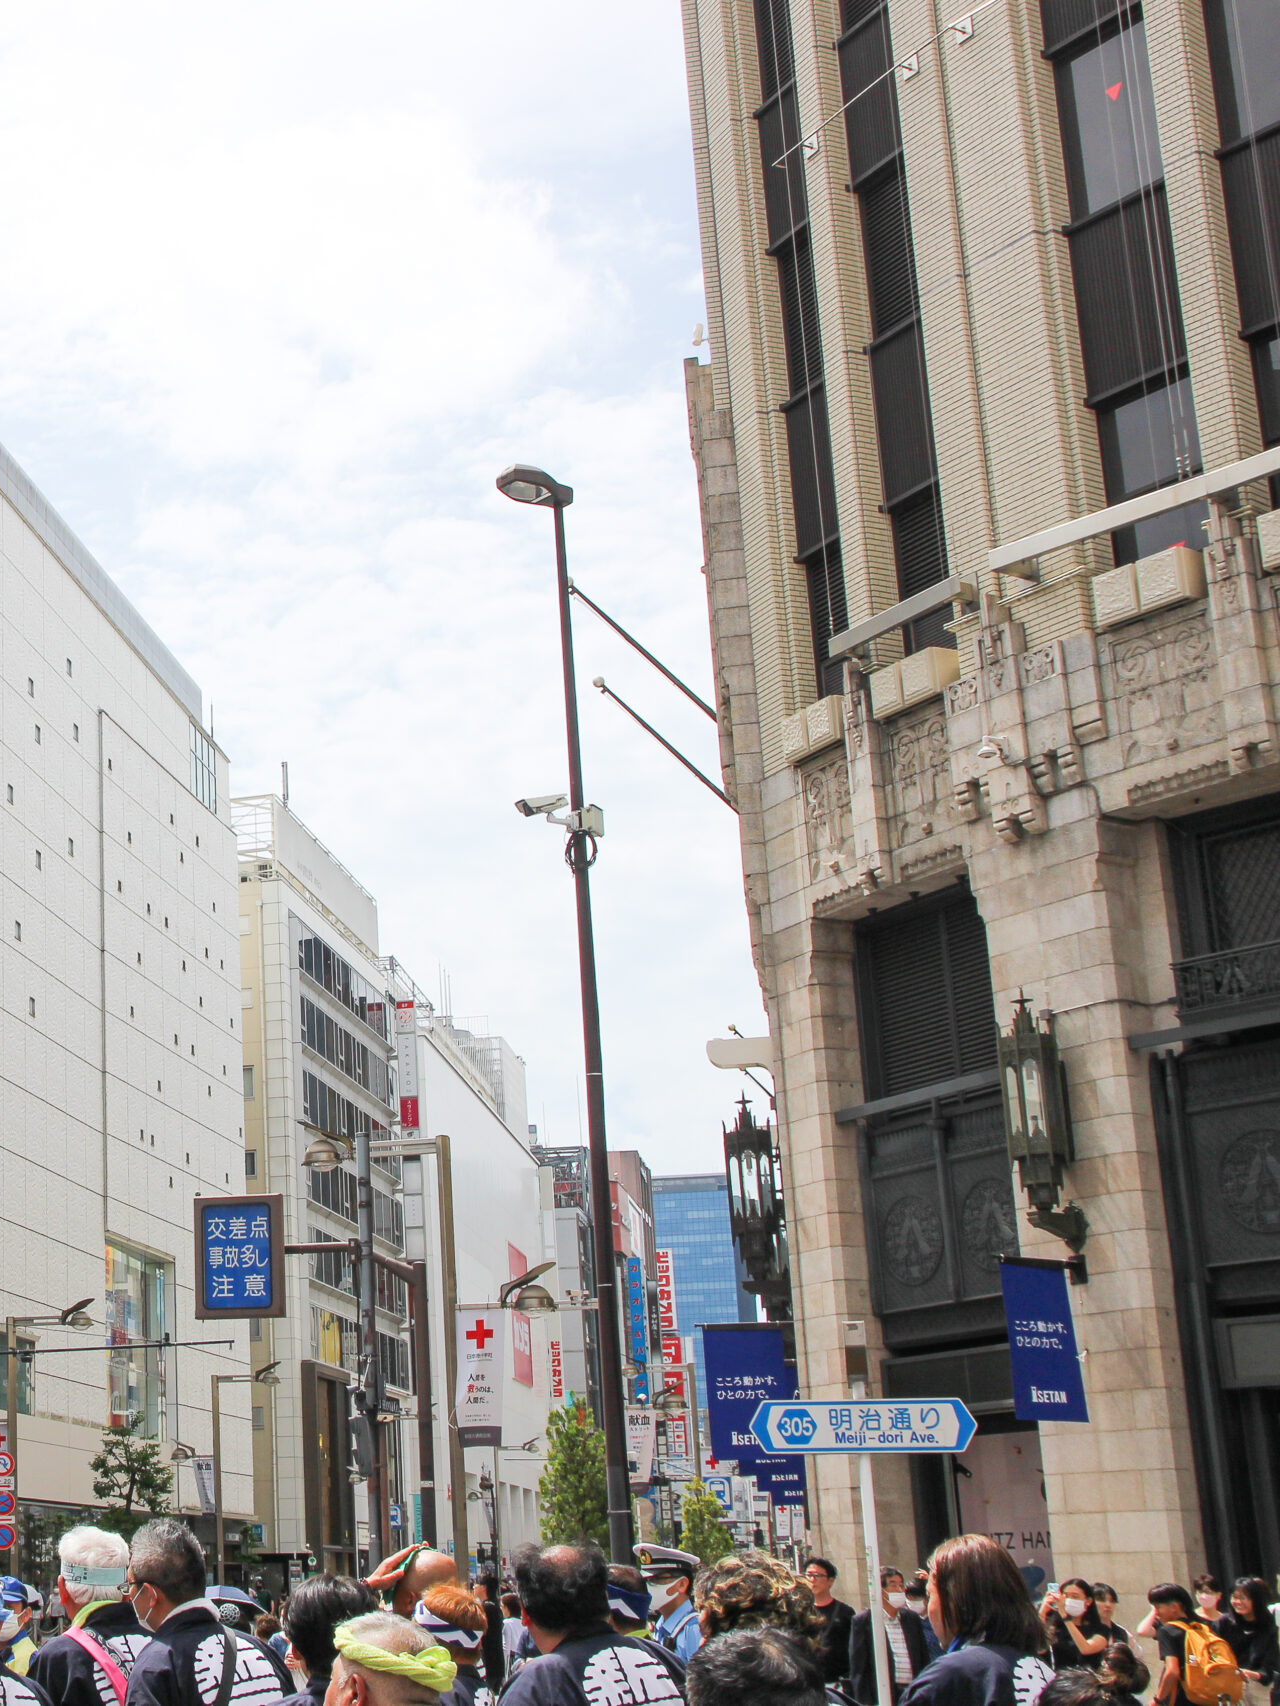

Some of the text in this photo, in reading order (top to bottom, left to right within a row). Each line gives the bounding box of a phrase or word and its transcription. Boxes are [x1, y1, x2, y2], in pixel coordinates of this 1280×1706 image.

[207, 1215, 269, 1240] 交差点
[208, 1244, 269, 1269] 事故多し
[212, 1273, 266, 1298] 注意
[1014, 1320, 1068, 1334] こころ動かす、
[1016, 1336, 1063, 1349] ひとの力で。
[715, 1375, 778, 1387] こころ動かす、
[716, 1388, 771, 1400] ひとの力で。
[1030, 1386, 1068, 1404] ISETAN
[628, 1414, 651, 1426] 献血
[780, 1417, 813, 1437] 305
[828, 1407, 940, 1432] 明治通り
[731, 1431, 759, 1446] ISET
[835, 1431, 939, 1447] Meiji-dori Ave.
